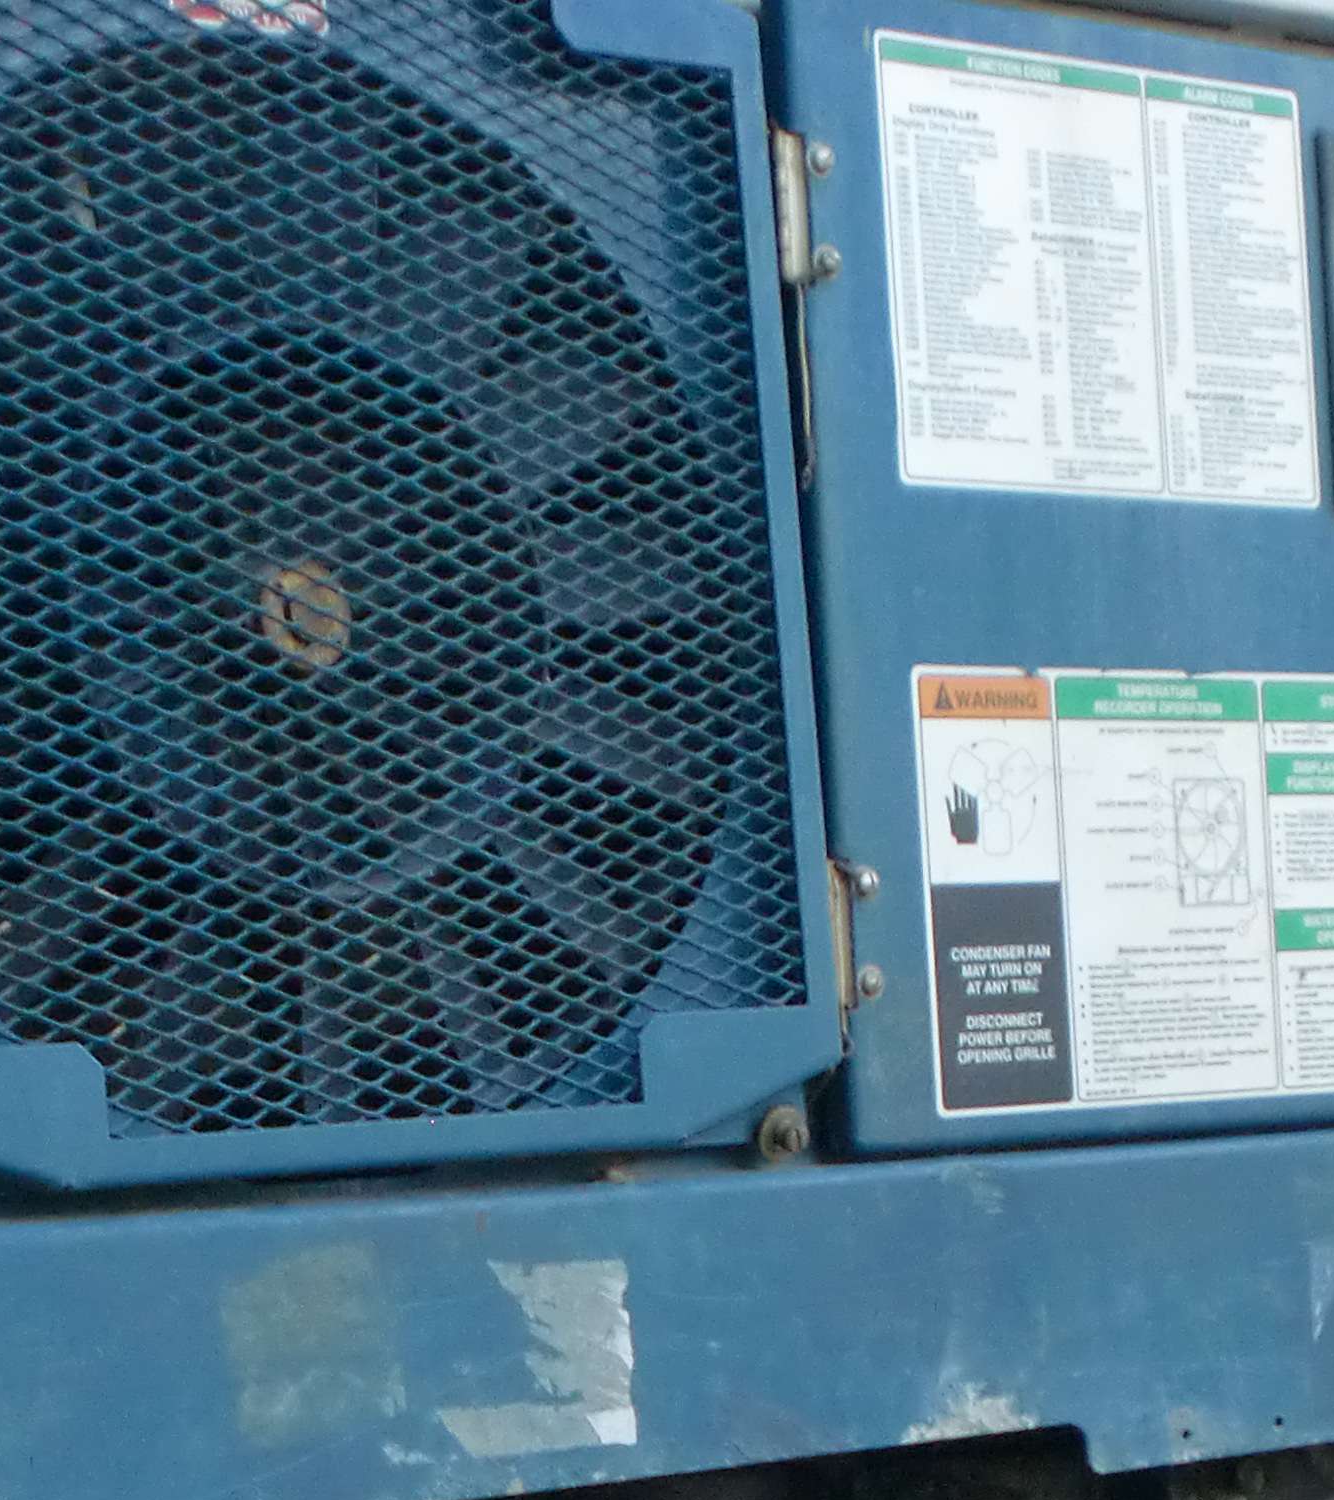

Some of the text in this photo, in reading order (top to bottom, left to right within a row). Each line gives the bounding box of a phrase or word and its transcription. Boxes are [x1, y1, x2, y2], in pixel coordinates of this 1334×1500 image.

[955, 689, 1037, 709] WARNING
[951, 944, 1051, 961] CONDENSER FAN
[961, 961, 1042, 977] MAY TURN ON
[966, 978, 1039, 995] AT ANY TIME
[966, 1012, 1043, 1029] DISCONNECT
[959, 1028, 1053, 1047] POWER BEFORE
[957, 1045, 1056, 1064] OPENING GRILLE
